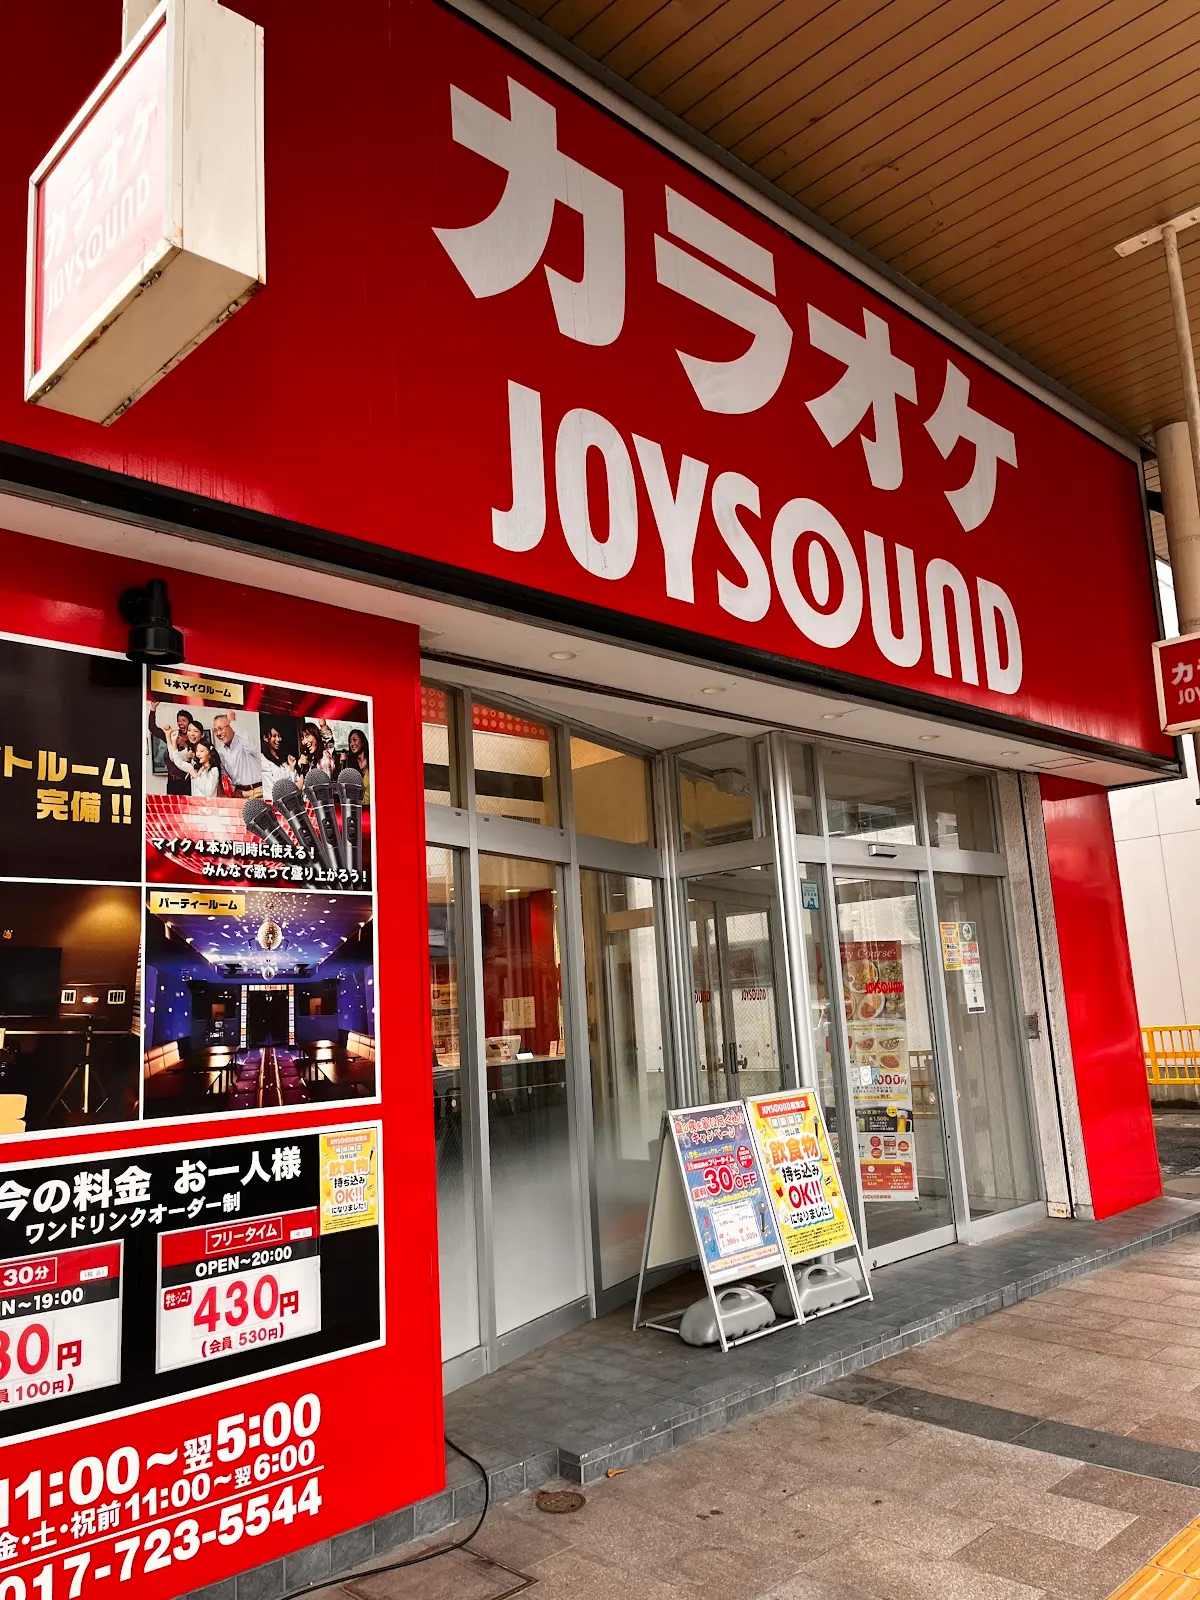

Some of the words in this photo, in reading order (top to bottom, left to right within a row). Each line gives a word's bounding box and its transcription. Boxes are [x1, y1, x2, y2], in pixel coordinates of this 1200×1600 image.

[42, 94, 159, 270] カラオケ
[44, 168, 151, 320] JOYSOUND
[431, 75, 1018, 532] カラオケ
[491, 379, 1023, 694] JOYSOUND
[163, 678, 232, 698] 4本マイクルーム
[0, 741, 131, 788] トルーム
[152, 837, 315, 861] マイク4本が同時に使える!
[202, 861, 368, 884] みんなで歌って盛り上がろう!
[158, 896, 238, 911] パーティールーム
[691, 1126, 736, 1146] キャンペーン
[769, 1135, 820, 1166] 飲食物
[0, 1165, 152, 1222] 今の料金
[173, 1146, 302, 1195] お一人様
[334, 1175, 365, 1188] 持ち込み
[781, 1162, 820, 1184] 持ち込み
[331, 1202, 367, 1214] になりました!
[335, 1187, 363, 1204] OK!!
[788, 1180, 824, 1210] OK!!
[25, 1191, 241, 1244] ワンドリンクオーダー制
[790, 1205, 832, 1225] になりました!
[210, 1223, 278, 1249] フリータイム
[2, 1265, 49, 1287] 30分
[0, 1287, 84, 1317] N~19:00
[193, 1274, 299, 1333] 430円
